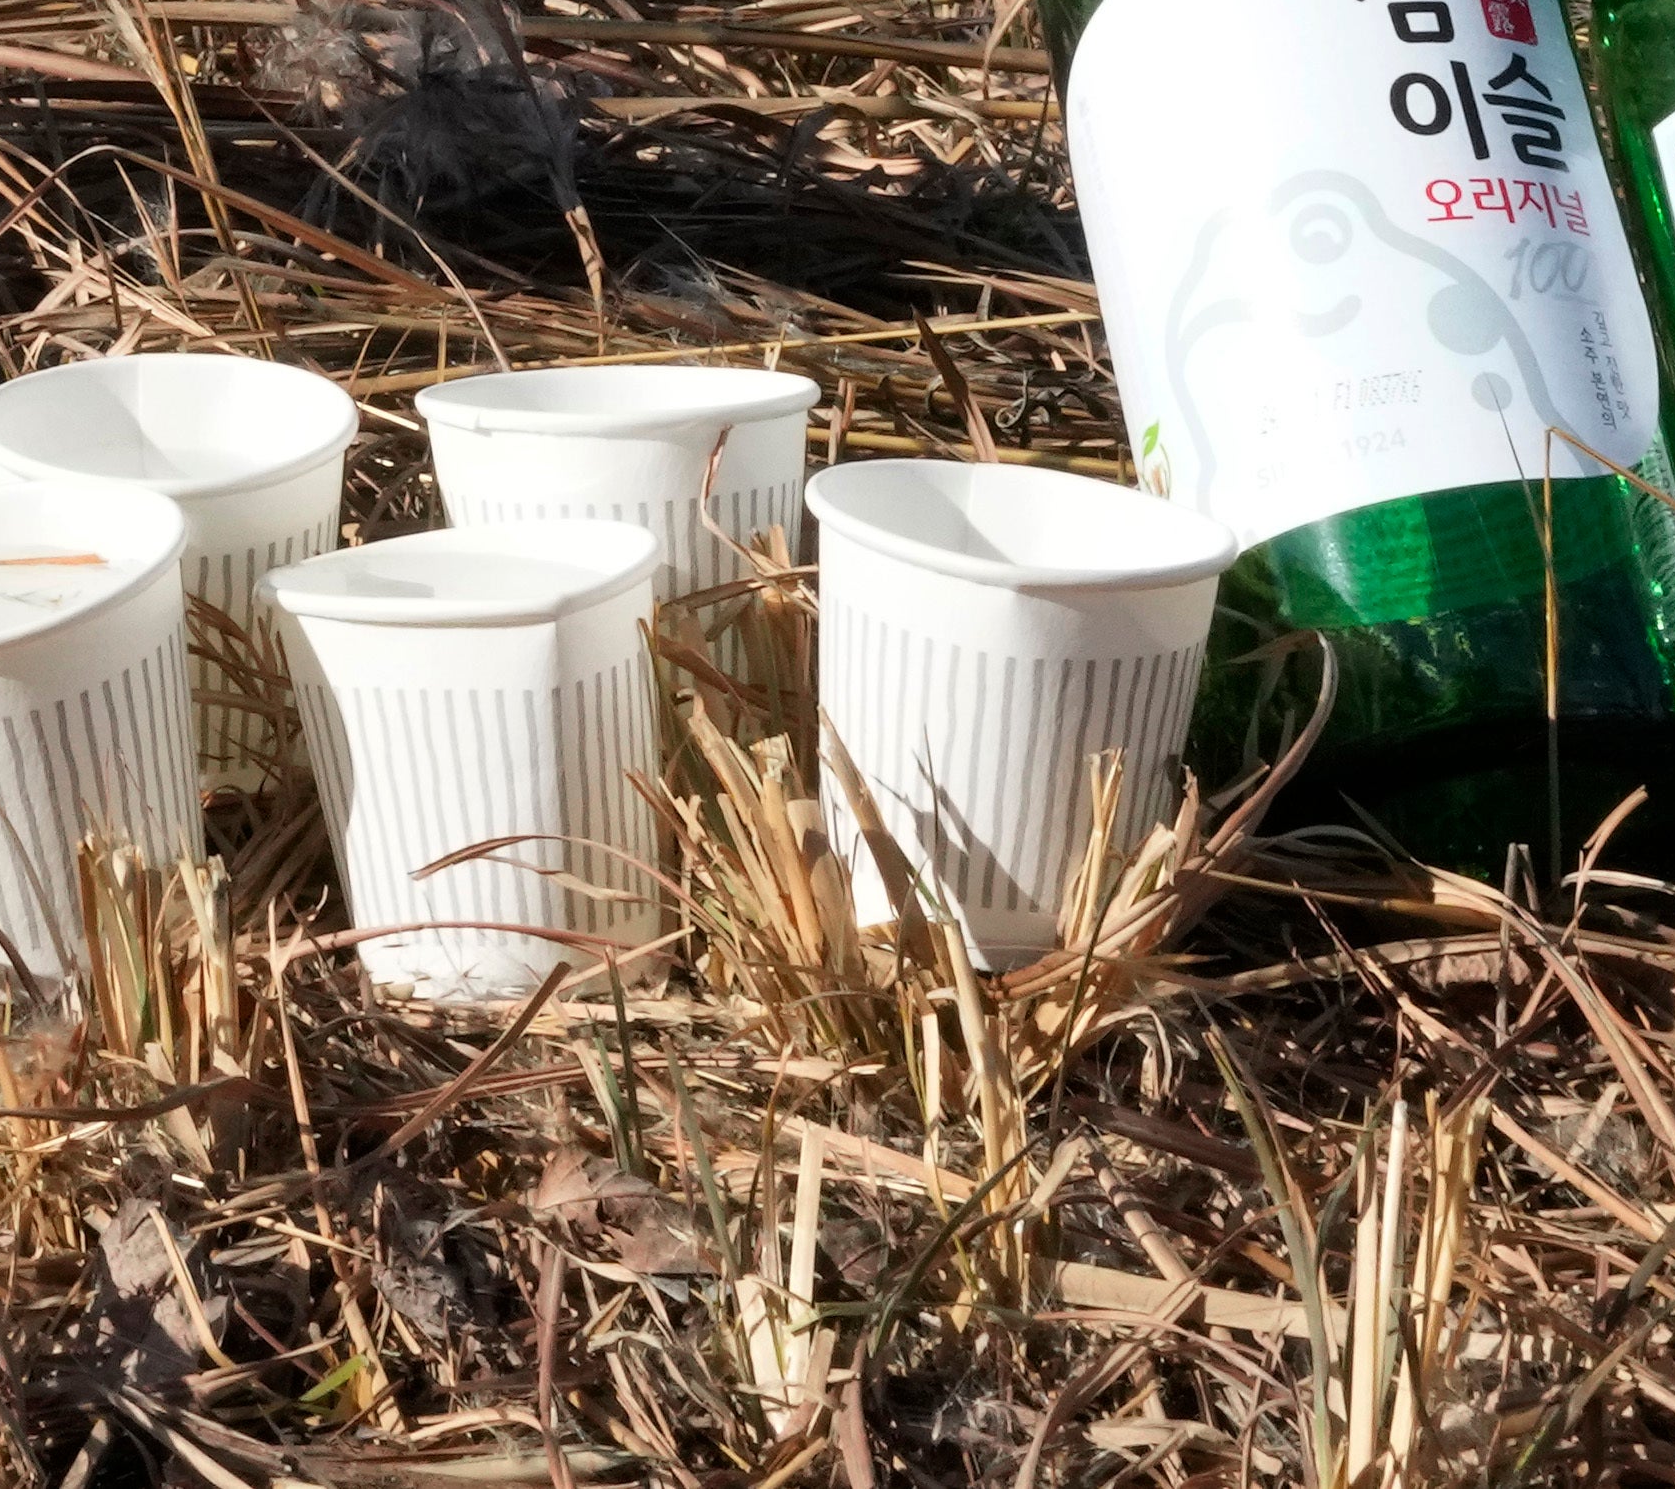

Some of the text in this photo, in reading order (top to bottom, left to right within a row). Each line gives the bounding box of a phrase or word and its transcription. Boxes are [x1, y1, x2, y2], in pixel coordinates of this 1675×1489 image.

[1390, 53, 1570, 173] 이슬
[1425, 178, 1591, 237] 오리지널
[1504, 236, 1592, 301] 100
